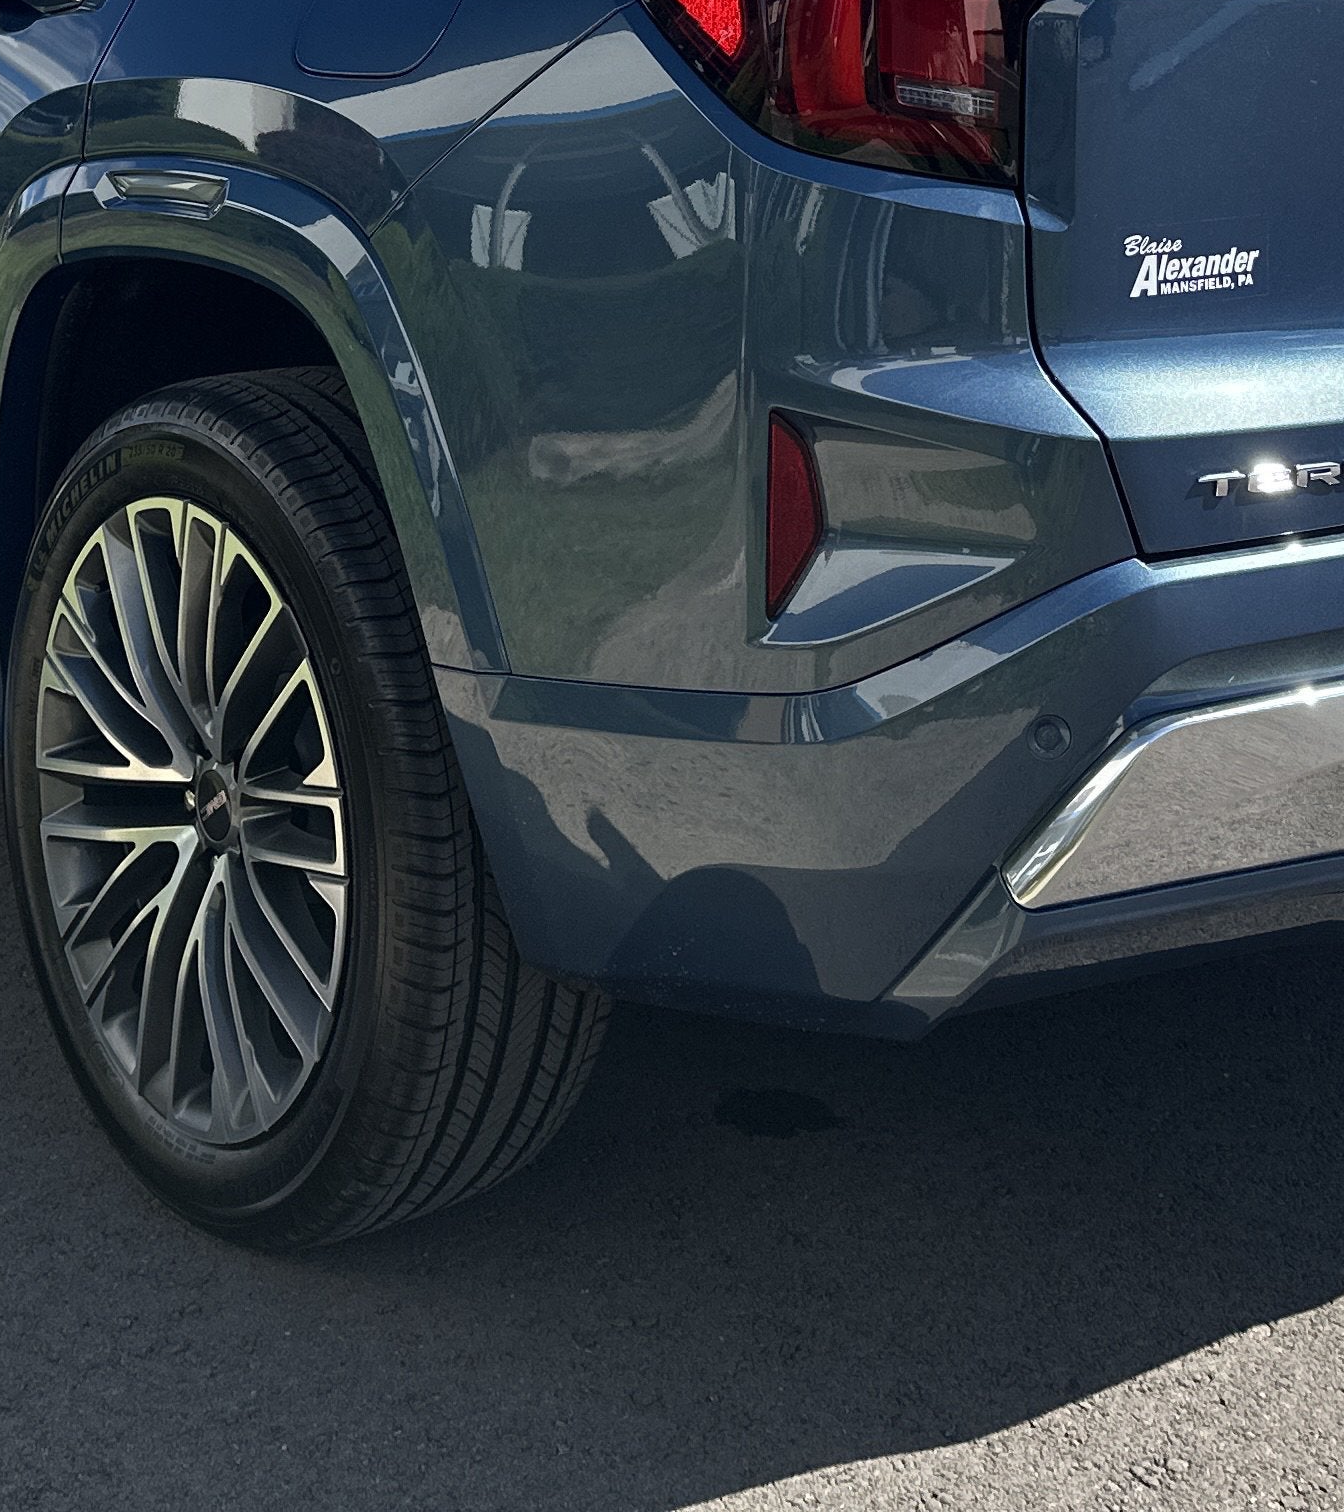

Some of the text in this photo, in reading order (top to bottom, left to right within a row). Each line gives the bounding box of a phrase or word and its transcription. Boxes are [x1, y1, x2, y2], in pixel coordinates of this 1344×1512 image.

[1123, 234, 1183, 257] Blaise
[1129, 246, 1260, 298] Alexander
[1160, 273, 1254, 295] MANSFIELD, PA
